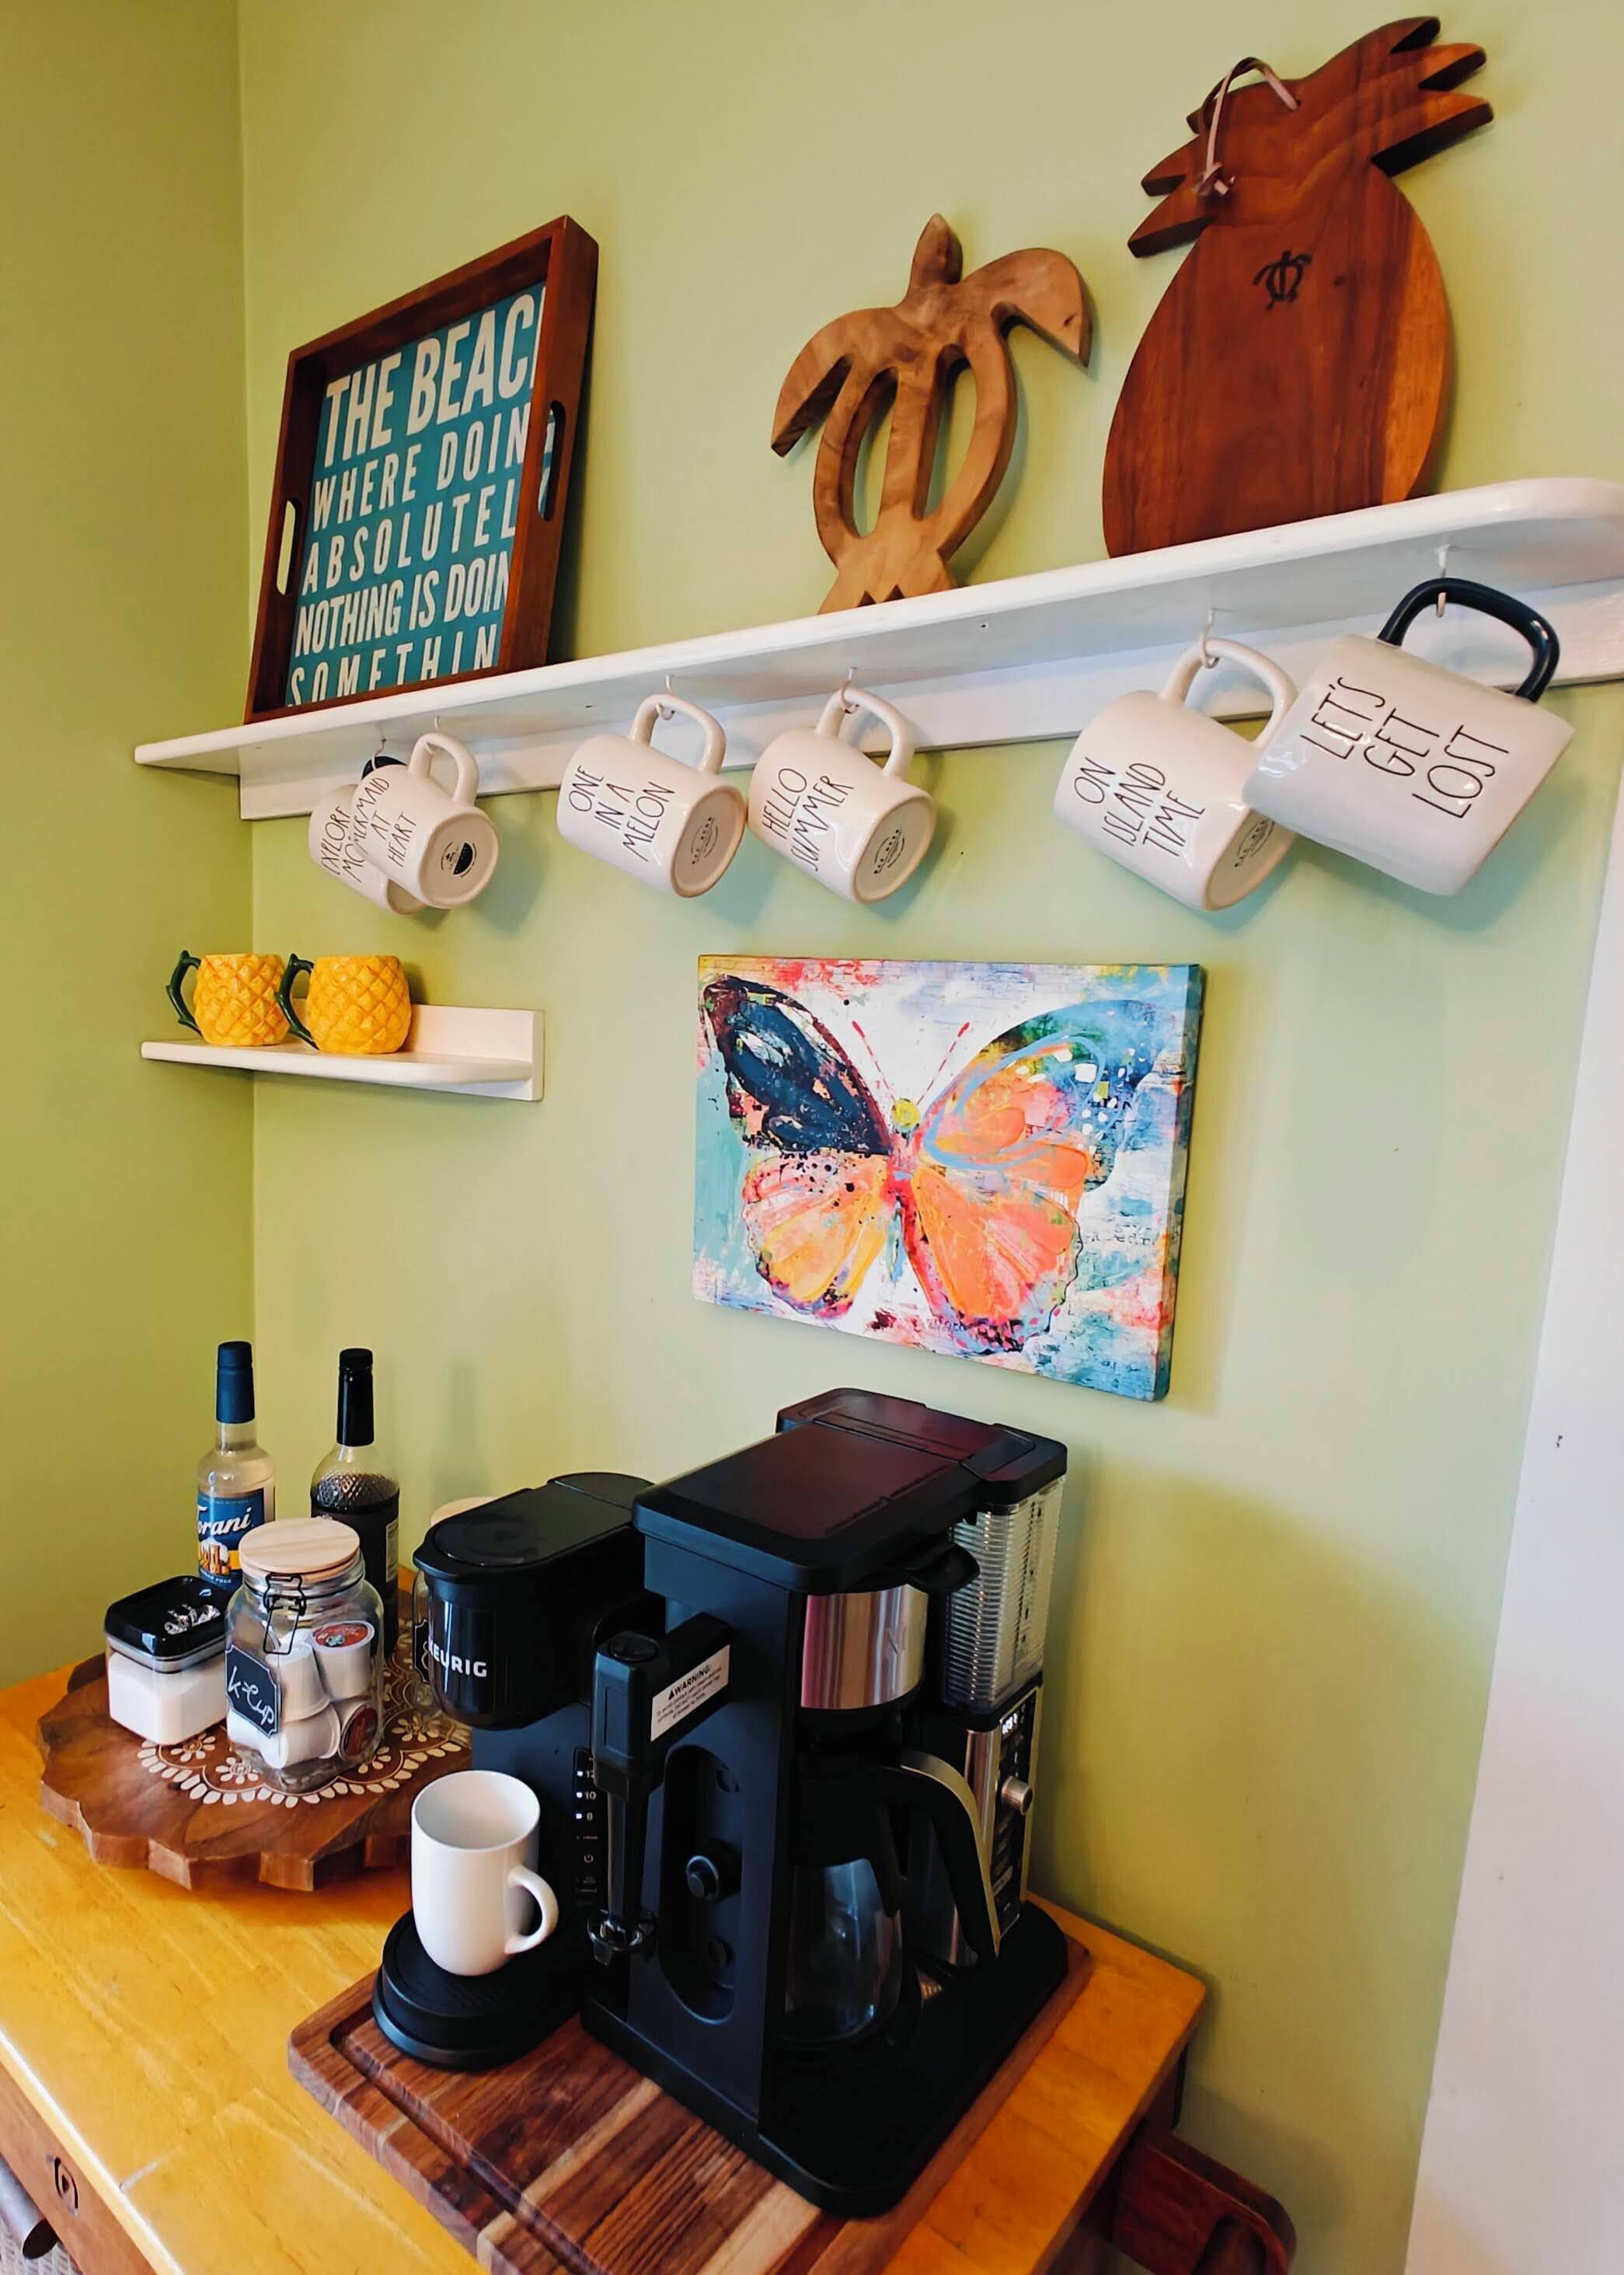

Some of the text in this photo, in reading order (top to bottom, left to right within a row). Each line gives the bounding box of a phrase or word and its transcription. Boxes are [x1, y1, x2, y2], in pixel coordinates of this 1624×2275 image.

[322, 286, 546, 468] THE BEAC
[312, 443, 422, 532] WHERE
[295, 578, 403, 658] NOTHING
[408, 568, 440, 626] IS
[1300, 675, 1385, 760] LET'S
[1363, 707, 1441, 777] GET
[568, 764, 605, 813] ONE
[594, 783, 636, 830] IN A
[761, 767, 808, 839] HELLO
[1073, 755, 1117, 805] ON
[1102, 761, 1167, 847] ISLAND
[1412, 724, 1510, 820] LOST
[371, 810, 392, 840] AT
[387, 811, 417, 868] HEART
[622, 780, 676, 863] MELON
[790, 774, 855, 872] SUMMER
[1141, 789, 1206, 858] TIME
[585, 1791, 597, 1801] 10
